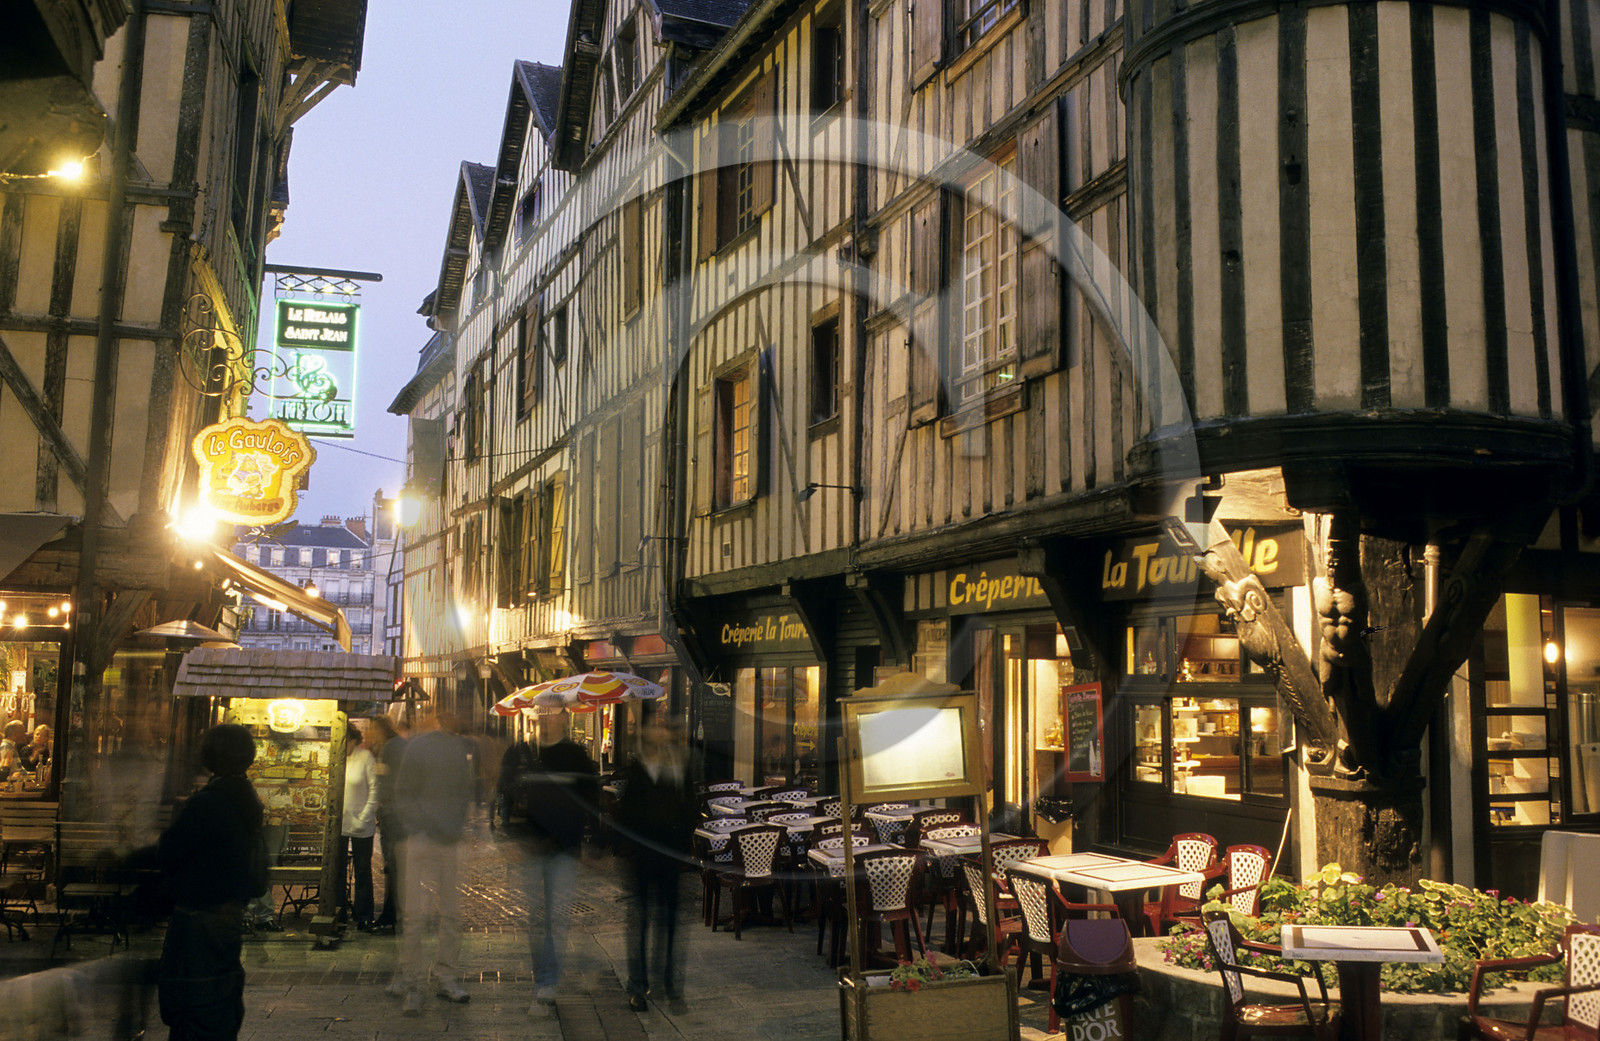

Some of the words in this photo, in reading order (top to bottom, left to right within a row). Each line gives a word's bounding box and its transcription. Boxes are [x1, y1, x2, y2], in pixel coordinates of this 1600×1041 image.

[303, 308, 348, 325] RELAIS
[284, 326, 320, 341] SAINT
[320, 327, 348, 343] JEAN
[209, 434, 226, 456] Le
[1102, 549, 1128, 589] la
[765, 616, 777, 640] la
[1071, 1018, 1122, 1041] D'OR
